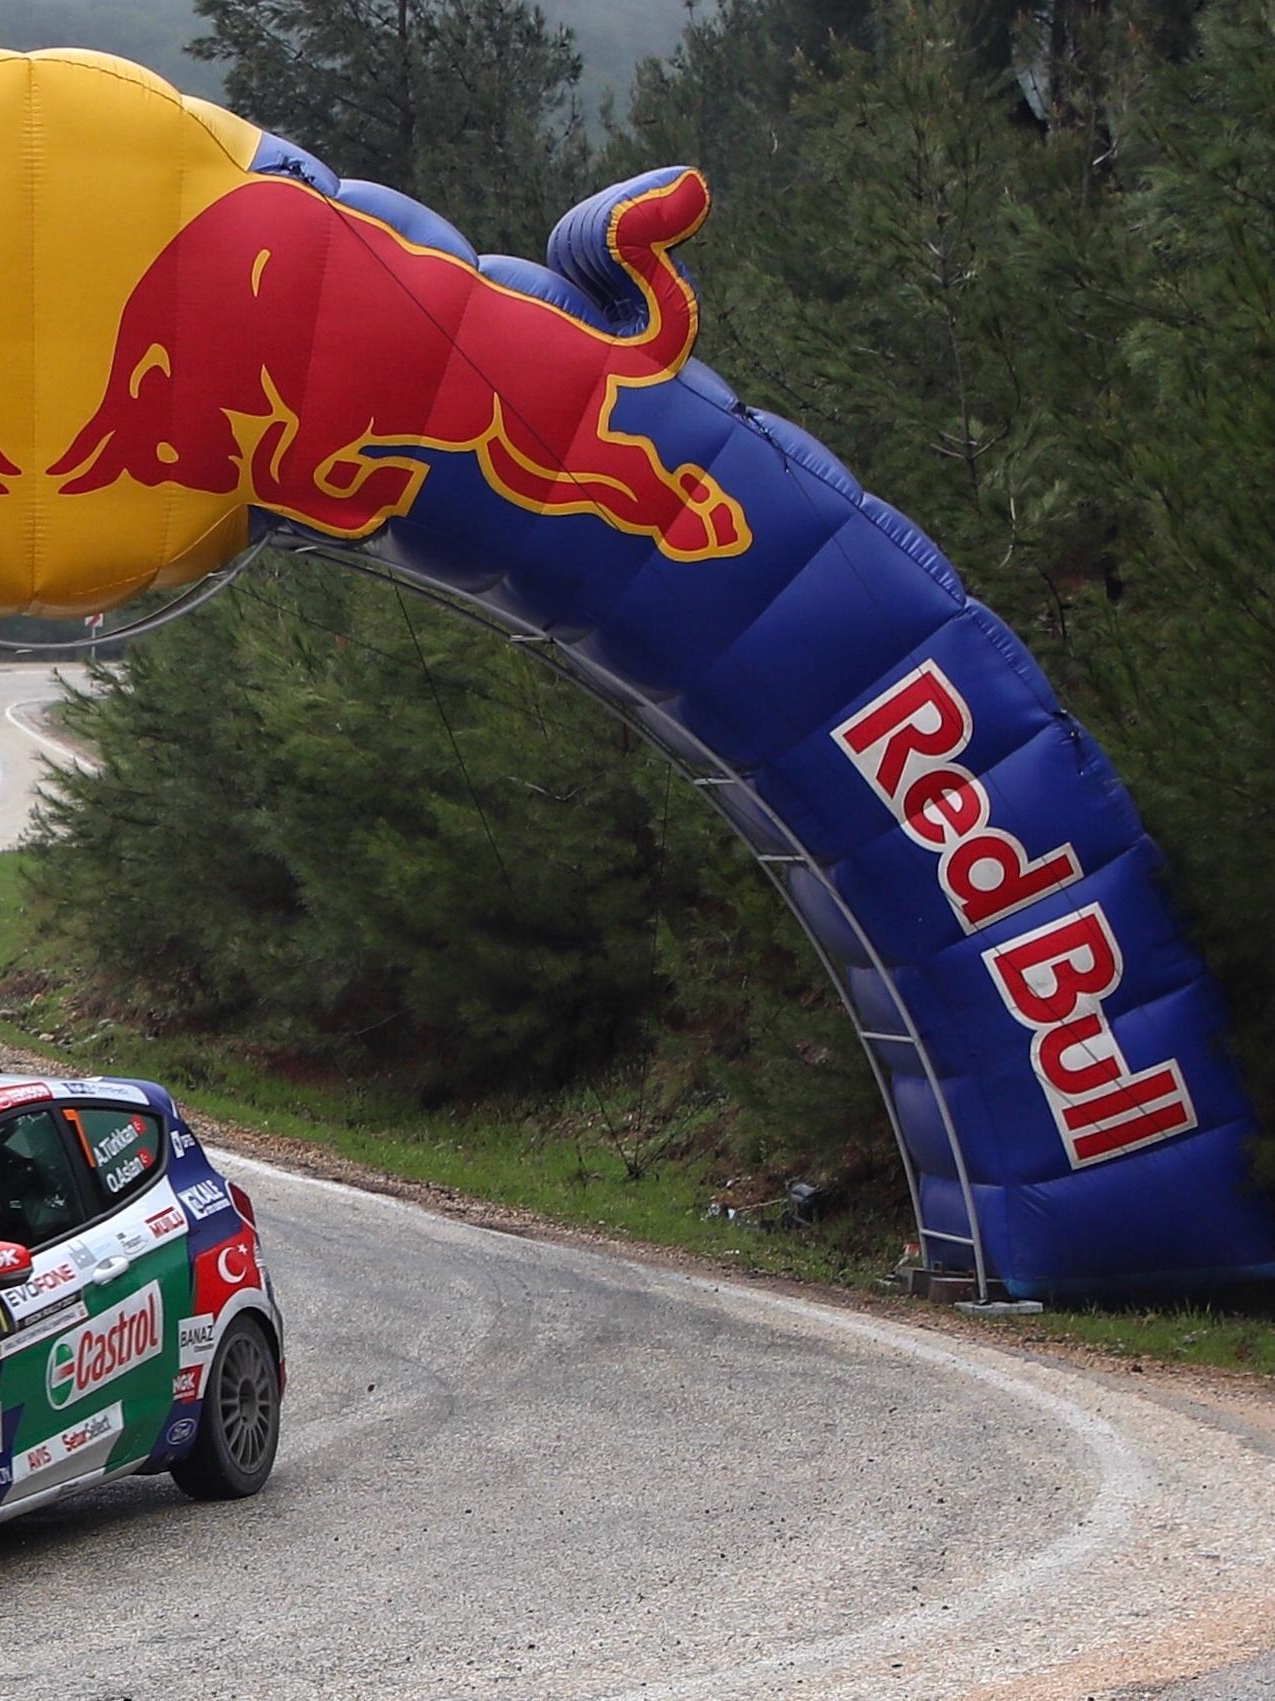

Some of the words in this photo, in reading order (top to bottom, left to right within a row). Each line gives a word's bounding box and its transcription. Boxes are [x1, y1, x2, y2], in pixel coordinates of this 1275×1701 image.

[829, 658, 1084, 936] Red
[981, 901, 1197, 1169] Bull
[5, 1264, 77, 1307] EVOFONE
[76, 1292, 158, 1390] Castrol
[181, 1325, 214, 1348] BANAZ
[173, 1372, 196, 1394] NGK
[27, 1446, 52, 1471] AVIS
